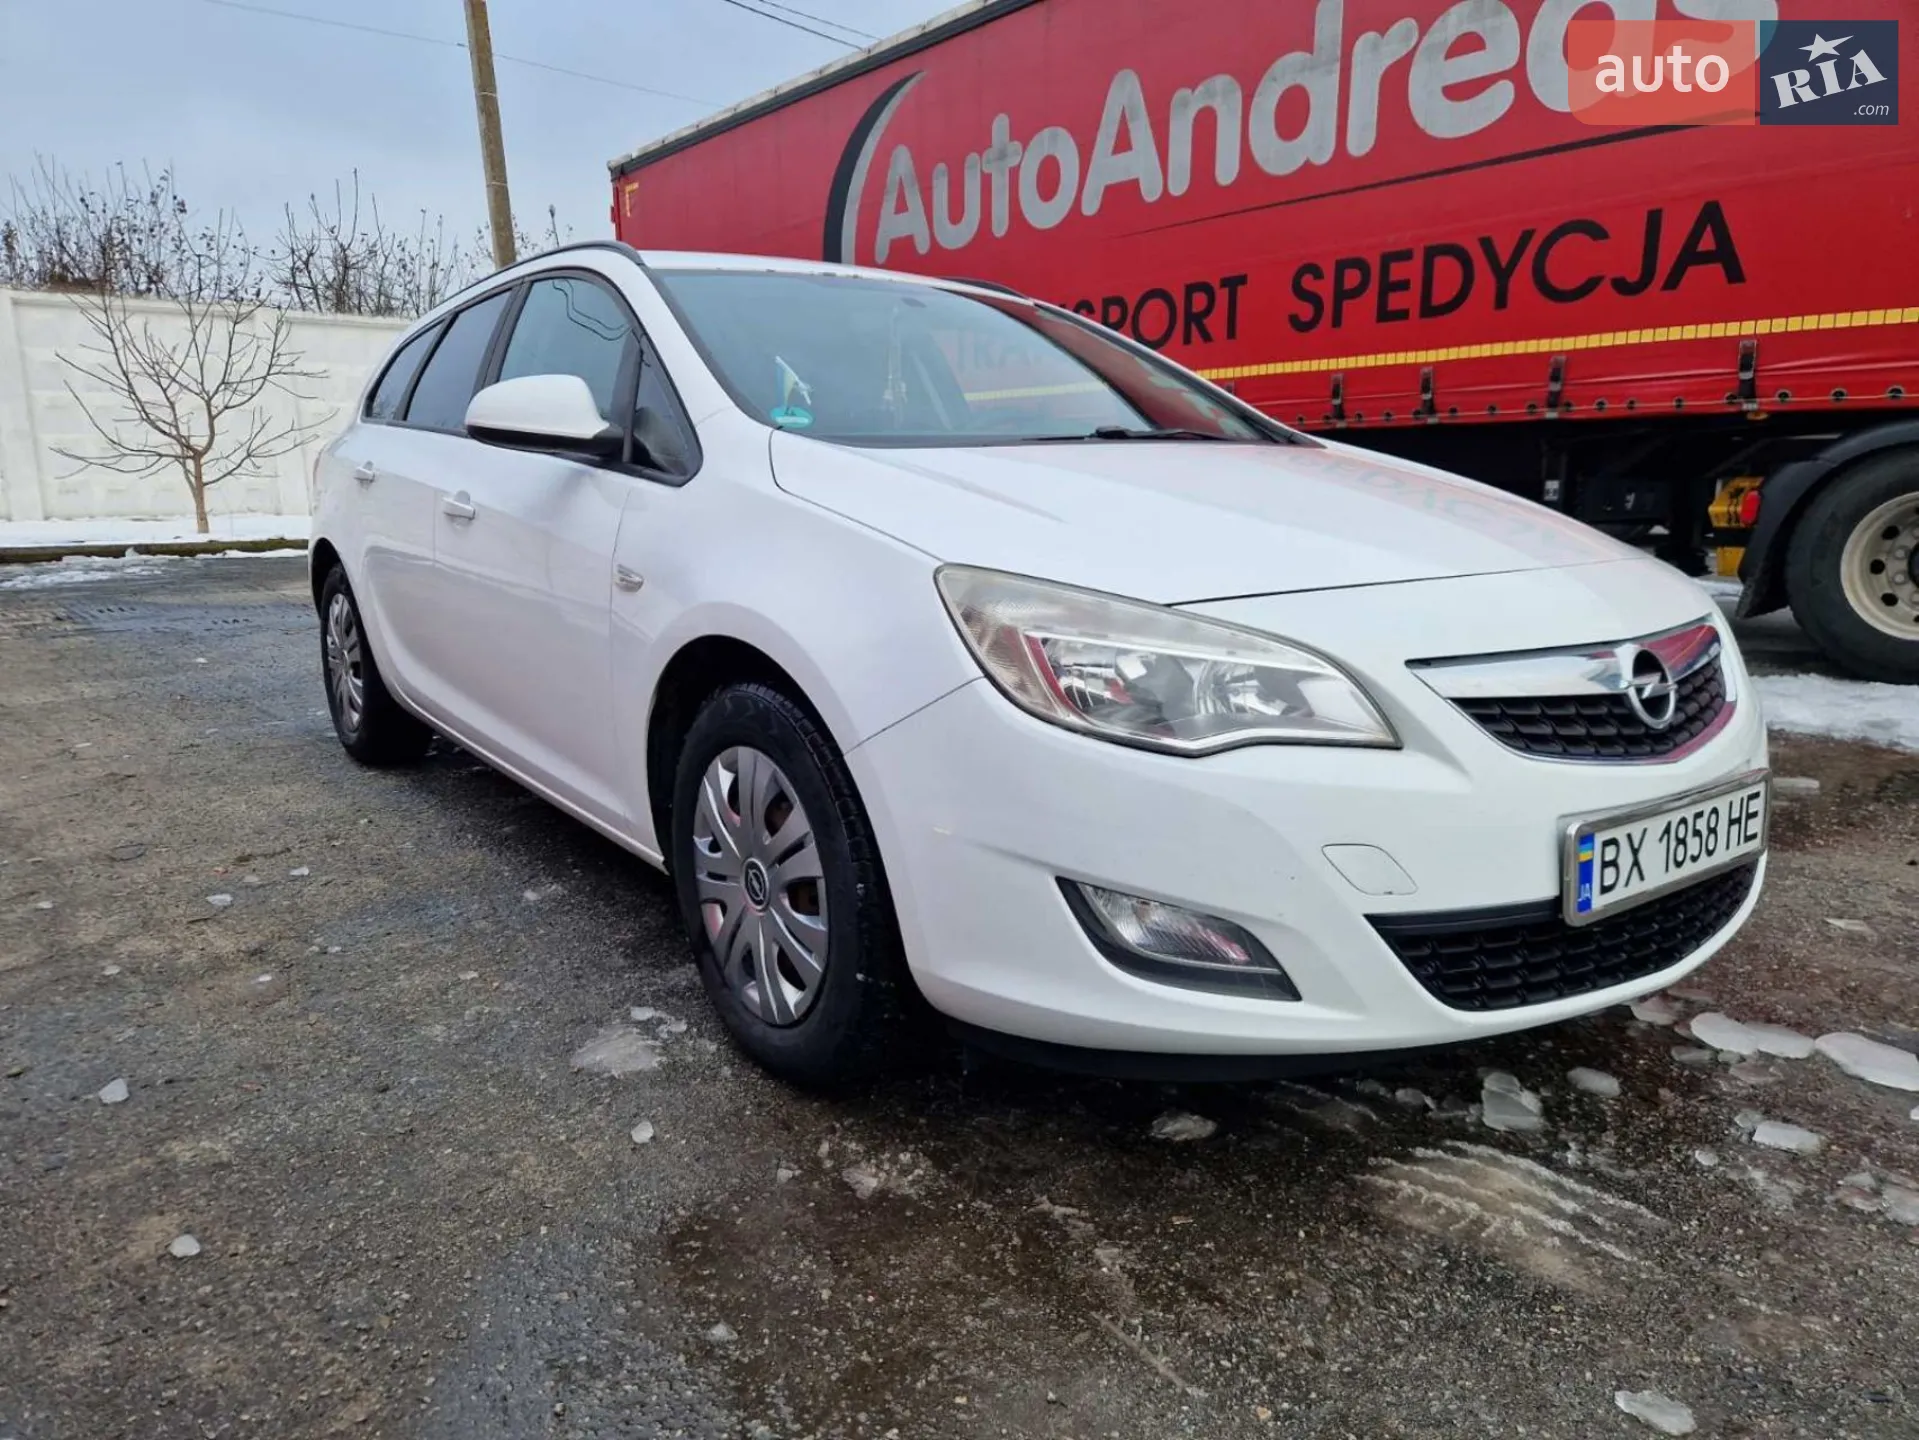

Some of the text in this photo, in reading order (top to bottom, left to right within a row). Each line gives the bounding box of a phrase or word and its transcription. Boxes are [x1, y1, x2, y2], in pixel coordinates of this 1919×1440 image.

[1287, 199, 1746, 333] SPEDYCJA
[1599, 791, 1761, 895] BX 1858 HE
